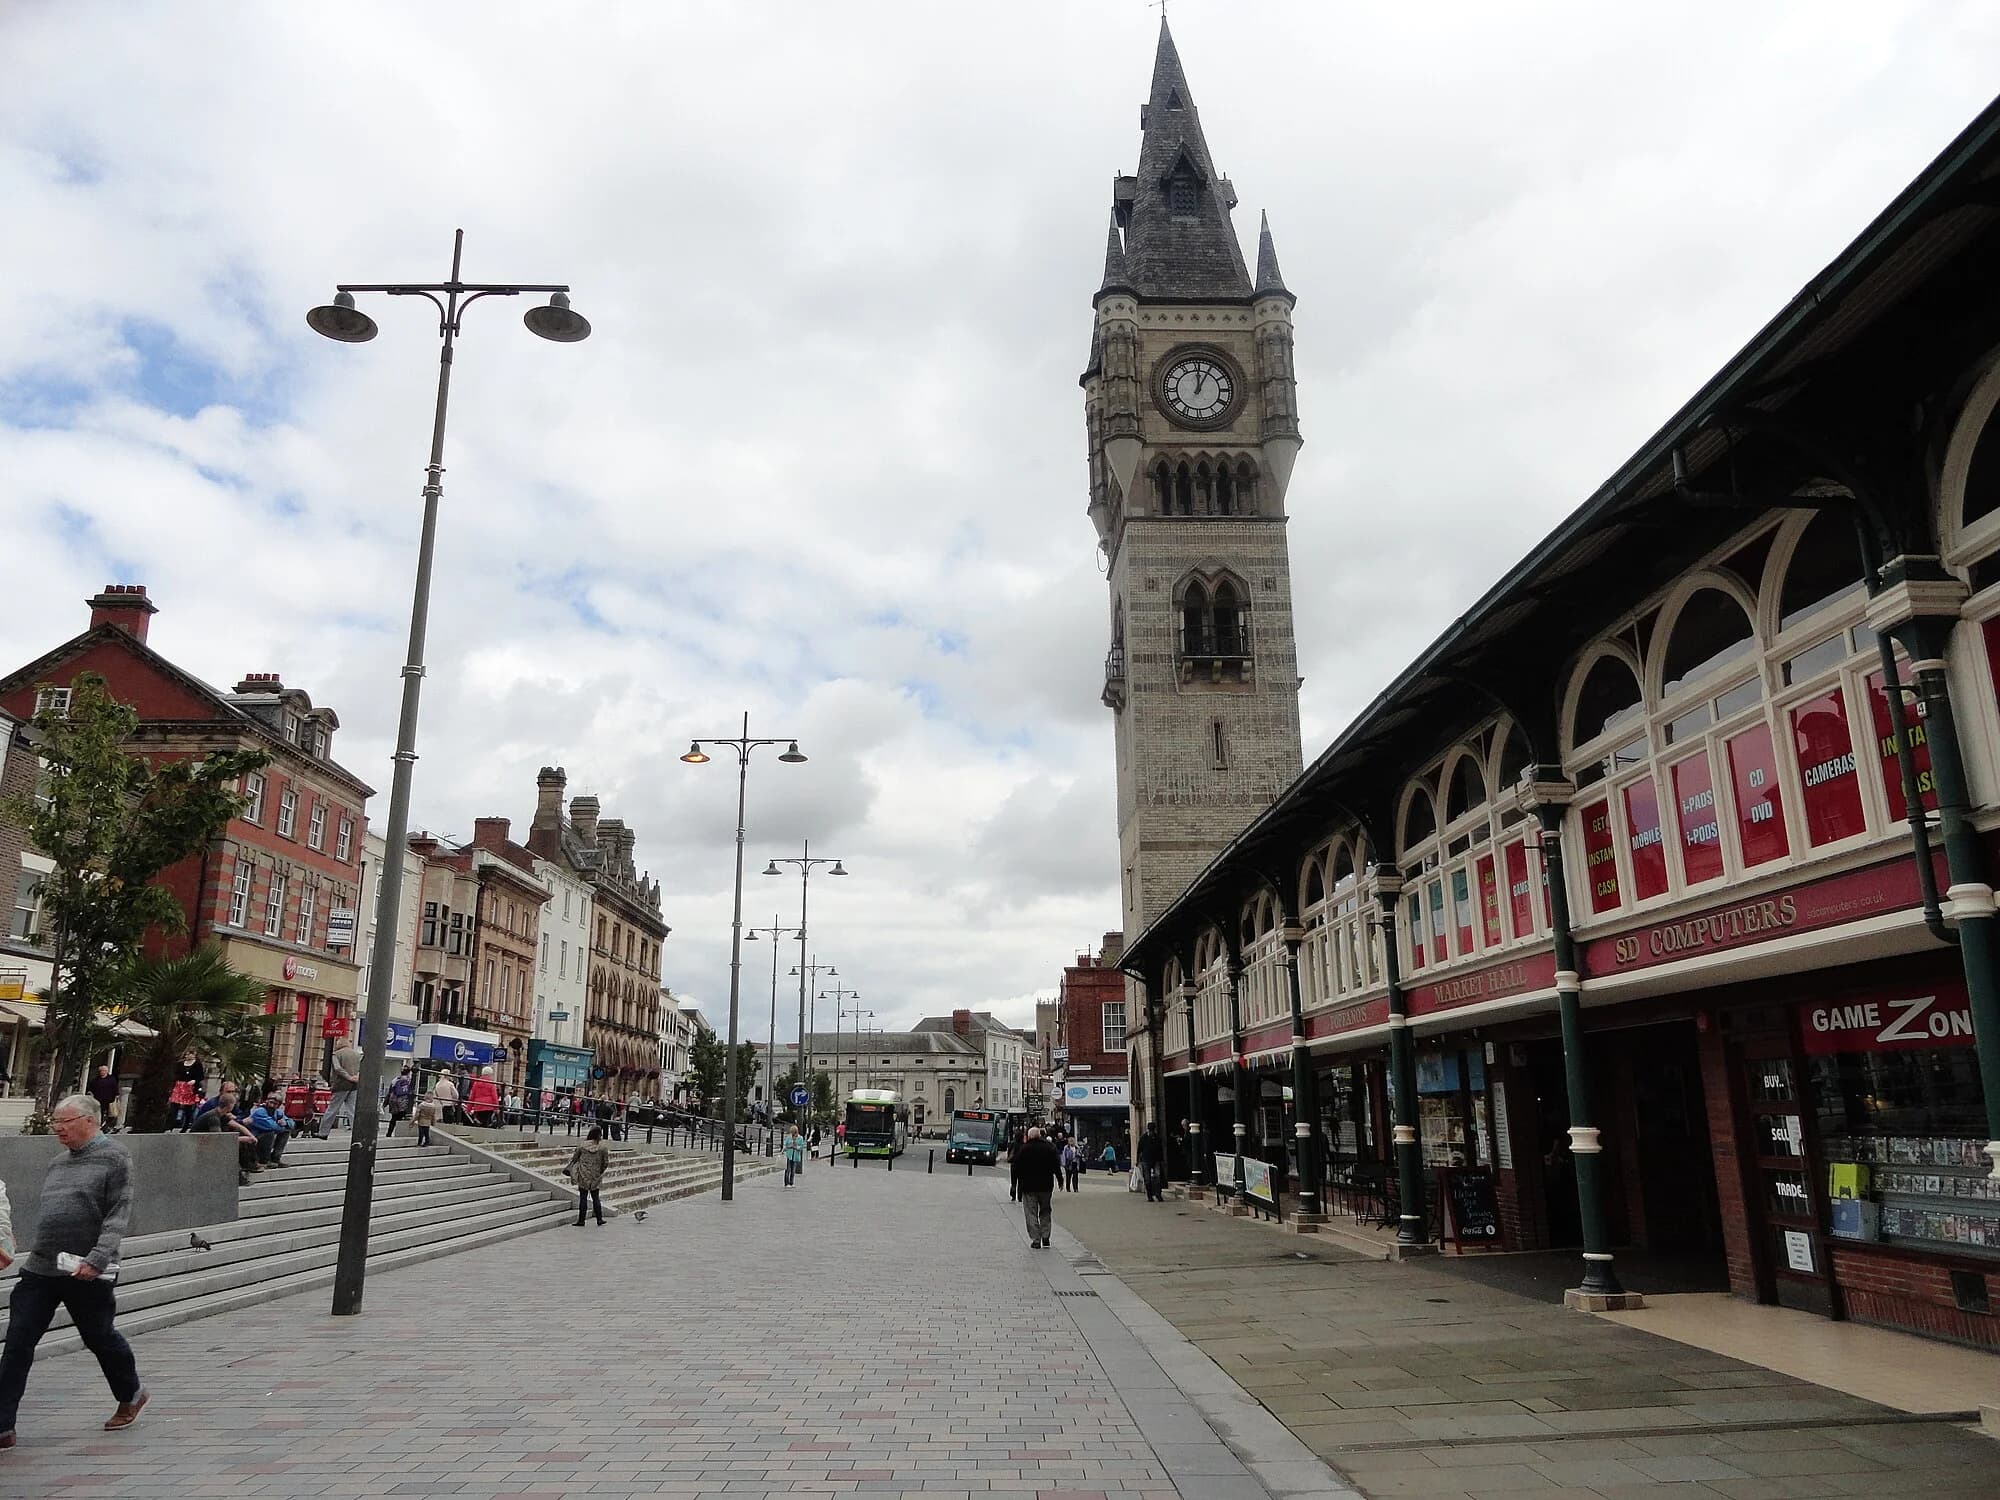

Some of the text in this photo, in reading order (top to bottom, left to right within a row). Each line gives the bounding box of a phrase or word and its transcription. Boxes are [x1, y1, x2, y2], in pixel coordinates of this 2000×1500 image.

[1882, 725, 1926, 757] INTA
[1749, 768, 1764, 788] CD
[1805, 752, 1857, 787] CAMERAS
[1682, 789, 1713, 815] i-PADS
[1751, 801, 1773, 823] DVD
[1592, 816, 1606, 833] GET
[1686, 822, 1718, 847] i-PODS
[1598, 879, 1617, 897] CASH
[1616, 895, 1797, 963] SD COMPUTERS
[296, 965, 318, 981] money
[1433, 965, 1527, 1003] MARKET HALL
[1812, 1003, 1882, 1032] GAME
[1092, 1086, 1122, 1095] EDEN
